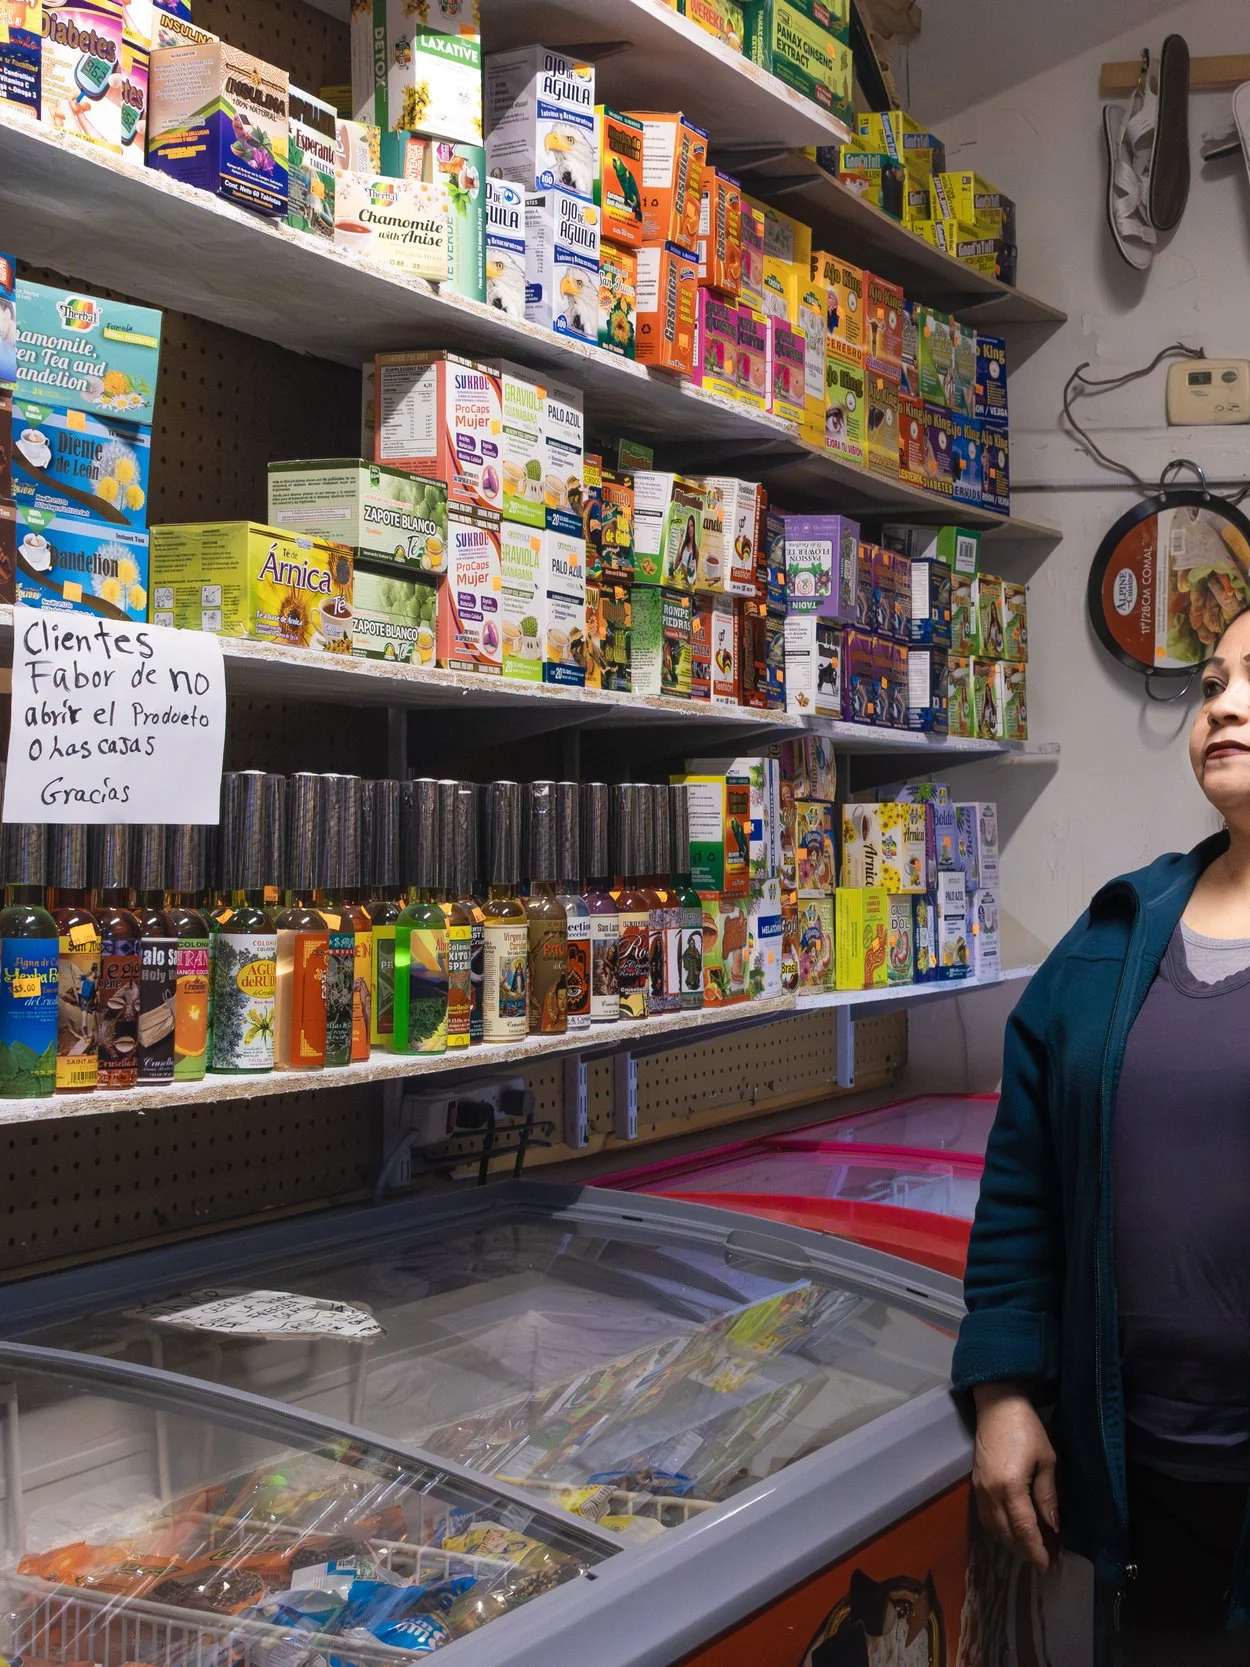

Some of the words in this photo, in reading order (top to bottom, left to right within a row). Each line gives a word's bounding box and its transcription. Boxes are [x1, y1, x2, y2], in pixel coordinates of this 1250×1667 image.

[41, 10, 117, 62] Diabetes
[421, 34, 480, 63] LAXATIVE
[776, 22, 802, 48] PANAX
[803, 38, 834, 71] GINSENG
[374, 26, 386, 88] DETOX
[545, 54, 565, 77] OJO
[566, 69, 575, 80] DE
[776, 40, 810, 69] EXTRACT
[226, 77, 287, 117] INSULINA
[543, 76, 591, 106] AGUILA
[493, 192, 502, 204] DE
[561, 198, 577, 222] OJO
[577, 213, 585, 224] DE
[358, 208, 443, 234] Chamomile
[378, 231, 400, 241] with
[401, 230, 443, 247] Anise
[559, 221, 597, 250] AGUILA
[60, 305, 98, 324] Therbal
[41, 349, 68, 370] Tea
[72, 358, 106, 377] and
[16, 367, 88, 392] andelion
[455, 374, 489, 391] SUKROL
[455, 403, 490, 414] ProCaps
[504, 383, 544, 413] GRAVIOLA
[455, 415, 490, 430] Mujer
[548, 404, 565, 423] PALO
[565, 411, 581, 428] AZUL
[58, 431, 103, 462] Diente
[55, 455, 70, 473] de
[72, 459, 100, 481] León
[364, 505, 402, 528] ZAPOTE
[401, 514, 436, 536] BLANCO
[115, 533, 134, 543] Instant
[136, 536, 145, 545] Tea
[406, 535, 418, 558] Té
[456, 531, 489, 549] SUKROL
[50, 543, 119, 578] Dandelion
[283, 548, 290, 557] Té
[501, 543, 540, 569] GRAVIOLA
[789, 554, 822, 562] PASSION
[1141, 545, 1153, 585] COMAL
[258, 542, 332, 595] Árnica
[456, 561, 490, 572] ProCaps
[551, 558, 567, 575] PALO
[456, 573, 490, 587] Mujer
[1117, 572, 1128, 611] ALPINE
[333, 592, 347, 616] Té
[664, 604, 689, 620] ROMPE
[792, 600, 817, 610] TADIN
[352, 618, 385, 638] ZAPOTE
[384, 622, 418, 642] BLANCO
[662, 616, 691, 631] PIEDRAS
[23, 619, 154, 659] Clientes
[25, 660, 116, 694] Fabor
[131, 661, 157, 688] de
[169, 667, 210, 696] no
[25, 699, 81, 727] abrir
[94, 701, 115, 726] el
[41, 776, 130, 806] Gracias
